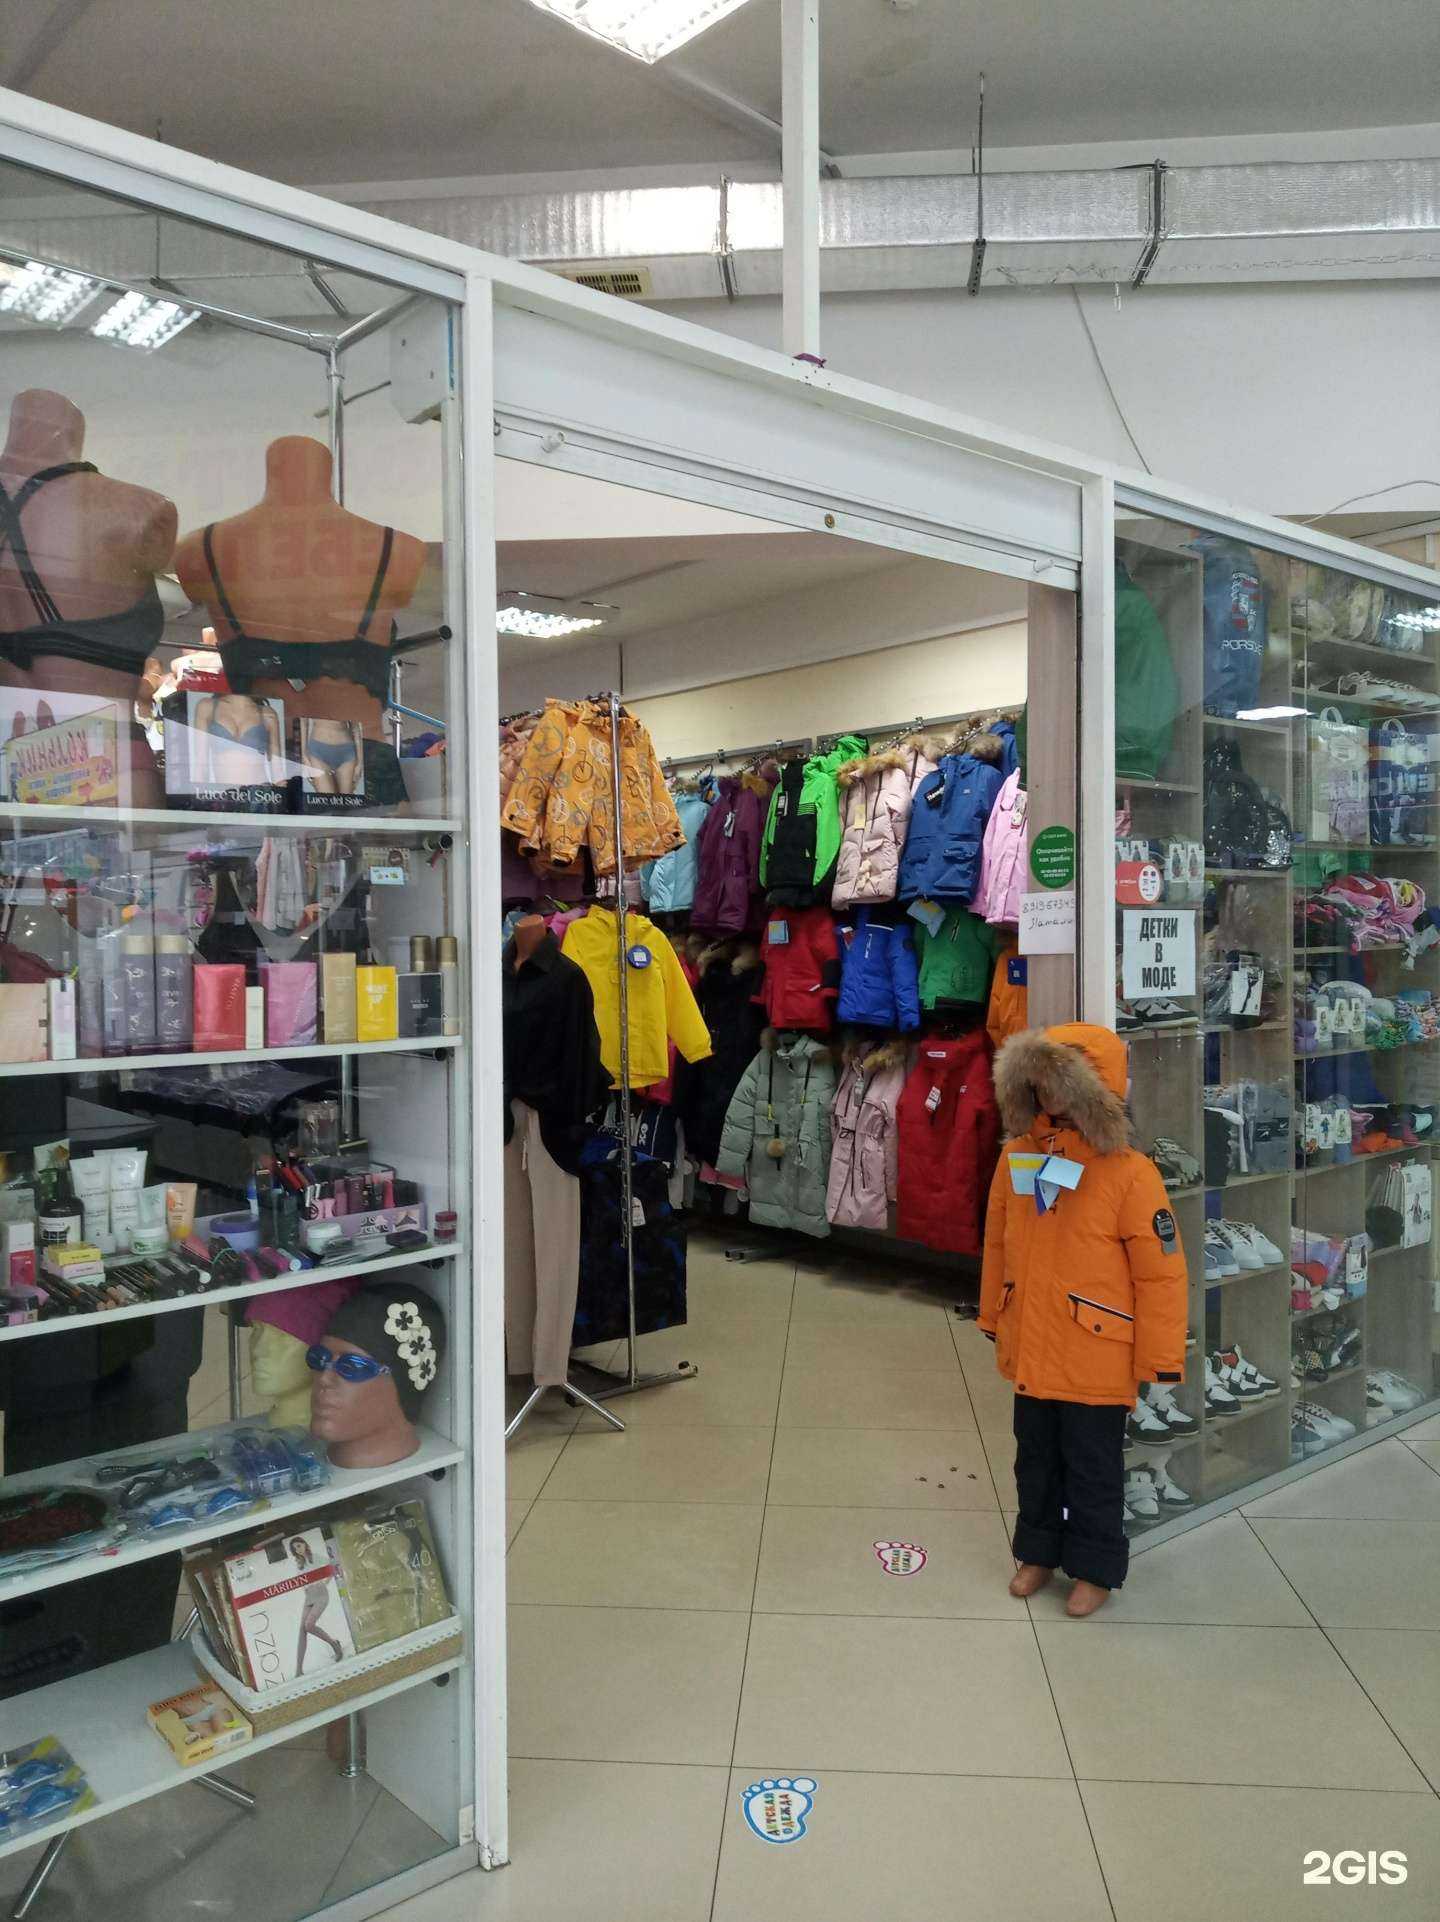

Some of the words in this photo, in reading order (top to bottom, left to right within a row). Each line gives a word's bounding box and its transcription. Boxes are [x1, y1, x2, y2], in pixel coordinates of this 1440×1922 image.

[195, 787, 228, 801] Luce
[229, 789, 251, 802] del
[254, 790, 283, 804] Sole
[306, 794, 328, 805] Luce
[345, 796, 364, 807] Sole
[1140, 917, 1178, 941] ДЕТКИ
[1155, 942, 1163, 963] В
[1141, 966, 1177, 990] МОДЕ
[262, 1574, 309, 1599] MARILYN
[764, 1792, 780, 1836] ДЕТСКАЯ
[779, 1793, 795, 1835] ОДЕЖДА
